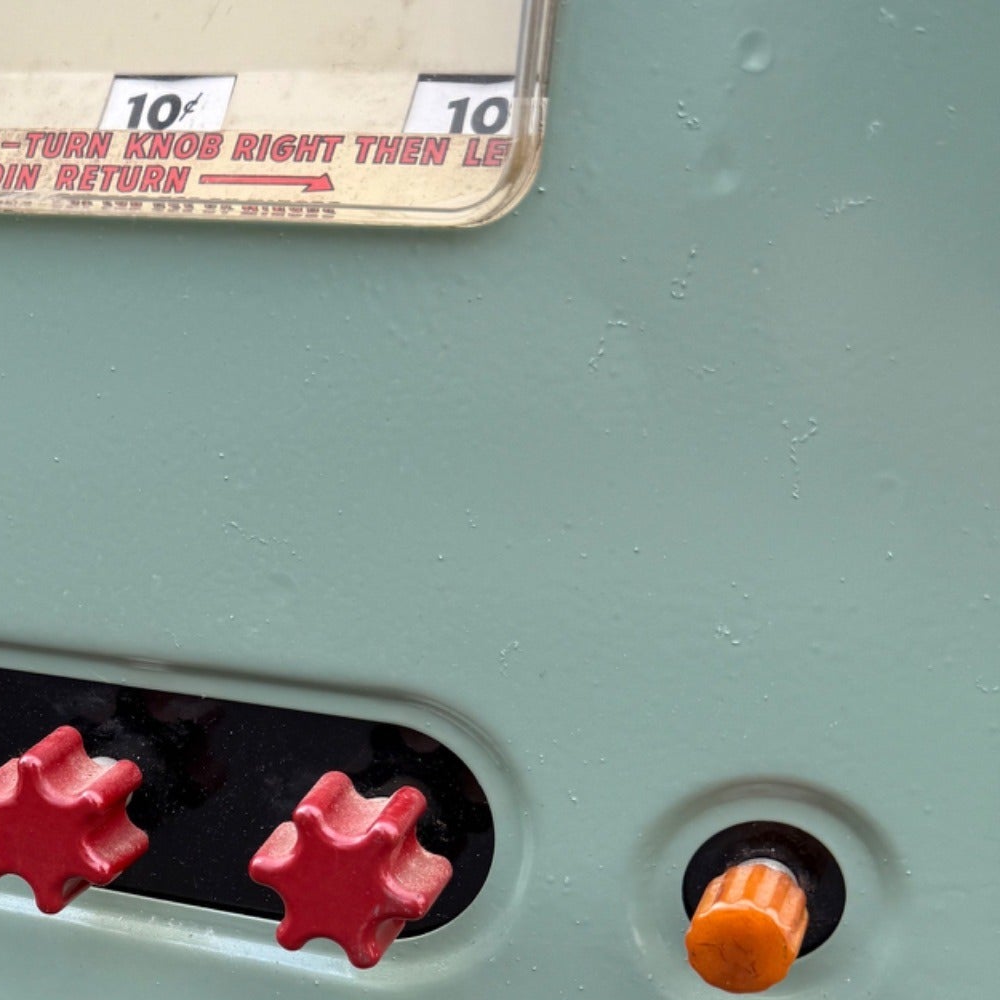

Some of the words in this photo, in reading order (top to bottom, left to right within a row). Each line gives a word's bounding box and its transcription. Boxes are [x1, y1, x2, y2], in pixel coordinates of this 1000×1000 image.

[127, 92, 203, 131] 10¢
[123, 132, 224, 160] KNOB
[231, 133, 345, 163] RIGHT
[354, 135, 450, 166] THEN
[55, 164, 192, 194] RETURN
